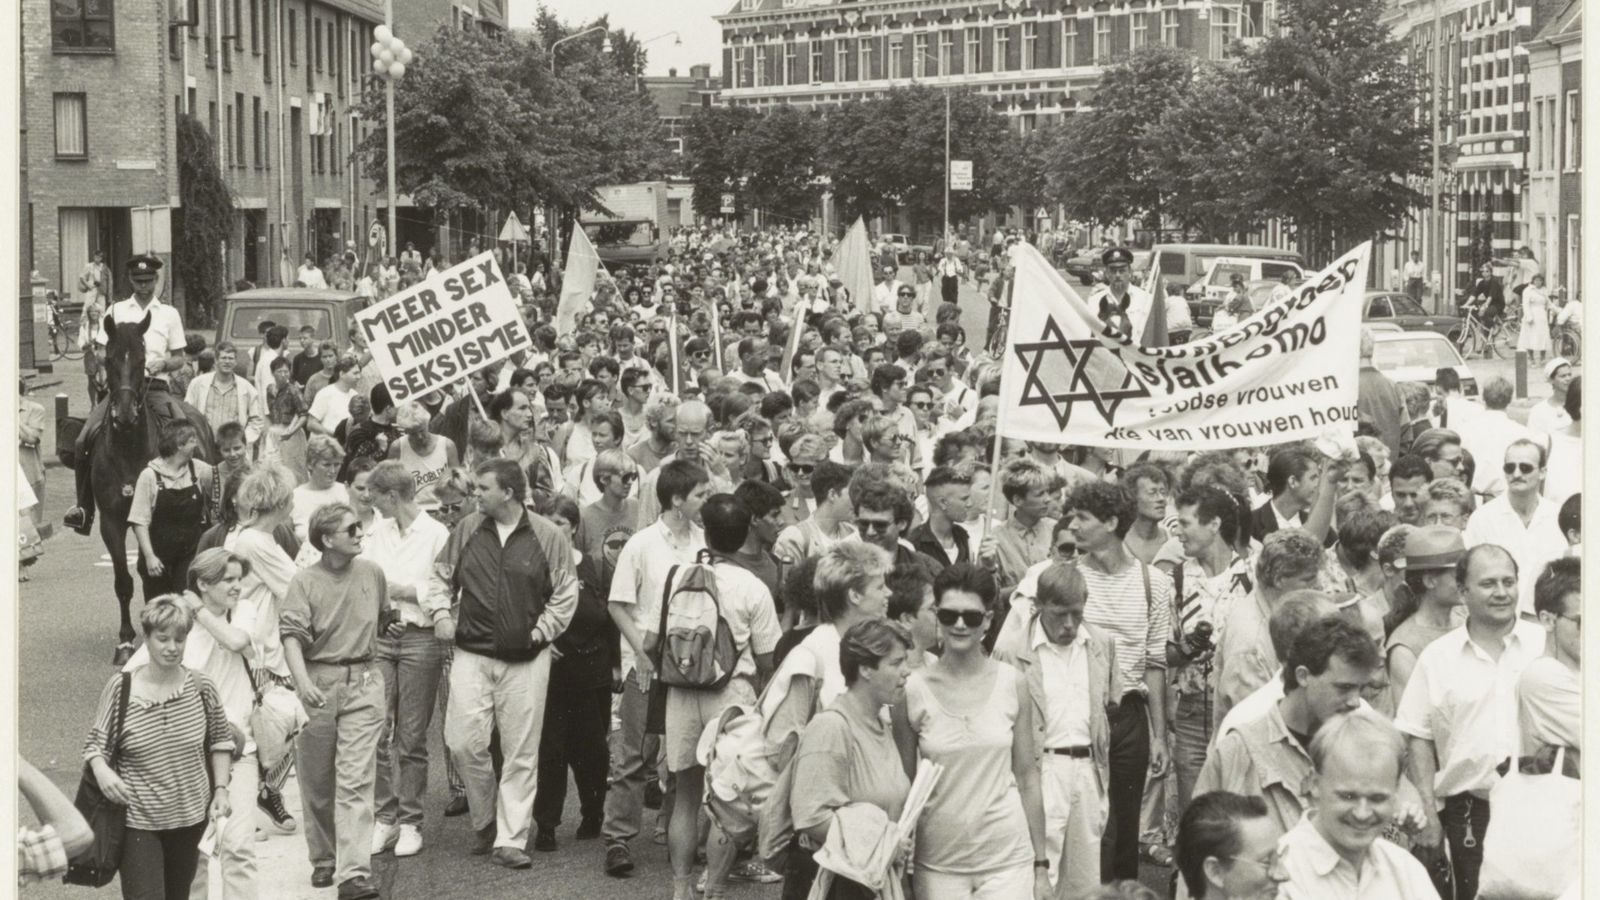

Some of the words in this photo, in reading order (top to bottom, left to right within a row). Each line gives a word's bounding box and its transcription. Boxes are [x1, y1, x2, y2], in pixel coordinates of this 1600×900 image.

[361, 289, 442, 342] MEER
[443, 259, 500, 301] SEX
[387, 302, 492, 366] MINDER
[1102, 258, 1359, 358] ouwengroep
[388, 320, 527, 400] SEKSISME
[1135, 315, 1326, 395] sjalhomo
[1104, 427, 1143, 441] die
[1147, 428, 1193, 441] van
[1199, 413, 1304, 440] vrouwen
[1149, 391, 1228, 417] odse
[1237, 374, 1339, 405] vrouwen
